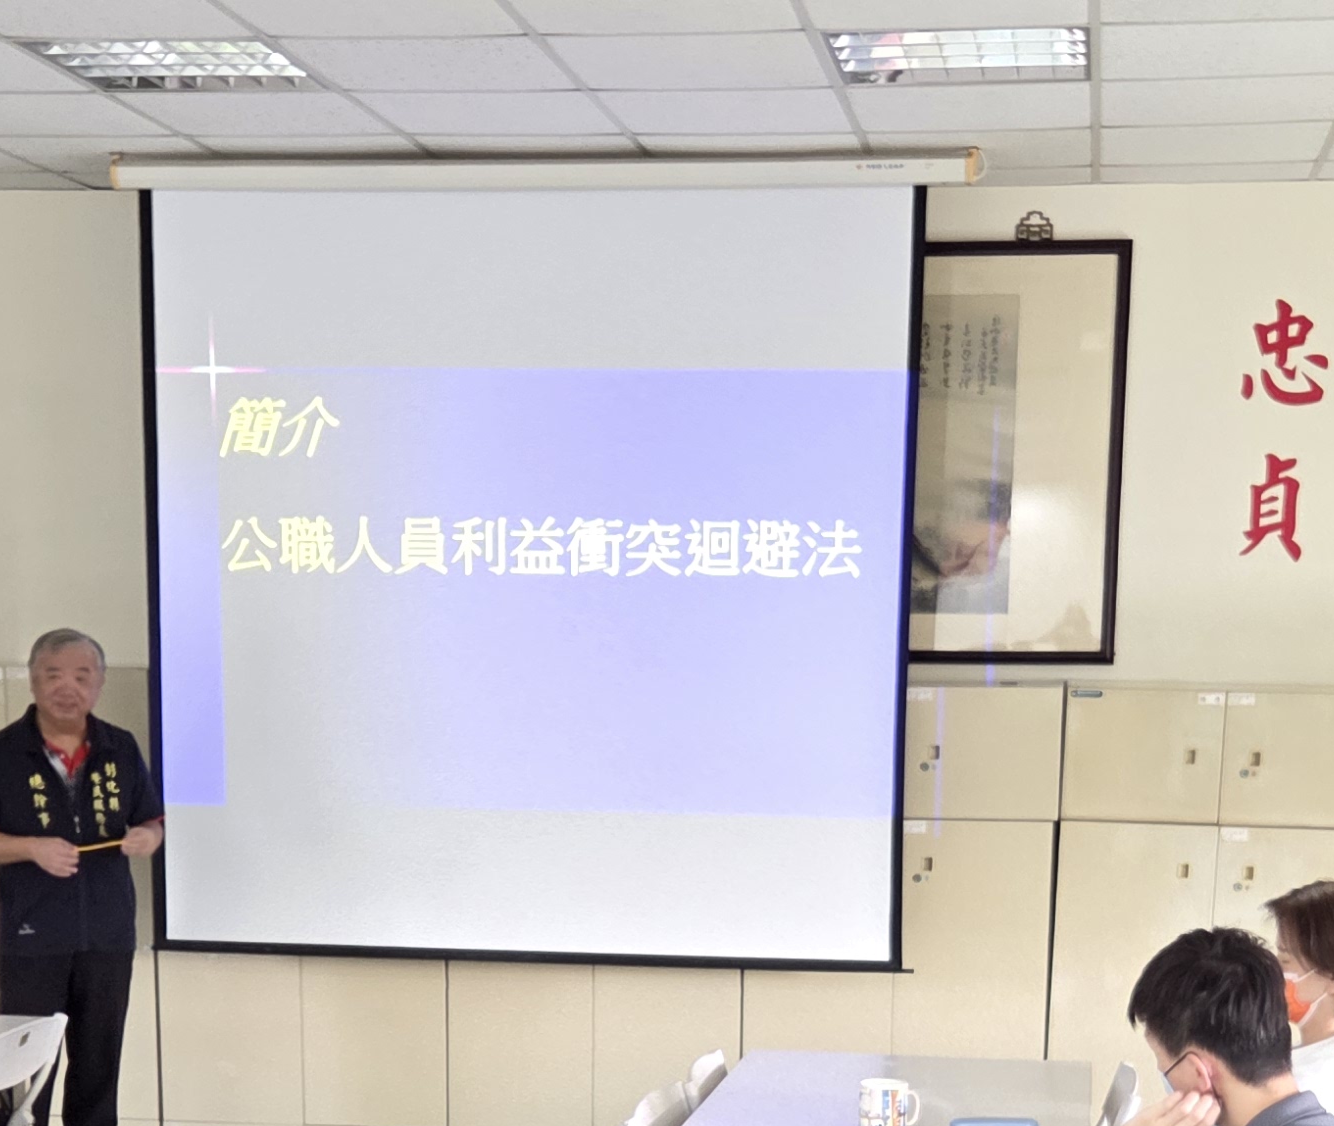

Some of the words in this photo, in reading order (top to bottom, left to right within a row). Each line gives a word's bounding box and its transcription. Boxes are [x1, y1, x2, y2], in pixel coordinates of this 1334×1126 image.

[219, 396, 340, 458] 簡介
[1240, 299, 1329, 562] 忠貞
[221, 515, 863, 579] 公職人員利益衝突迴避法
